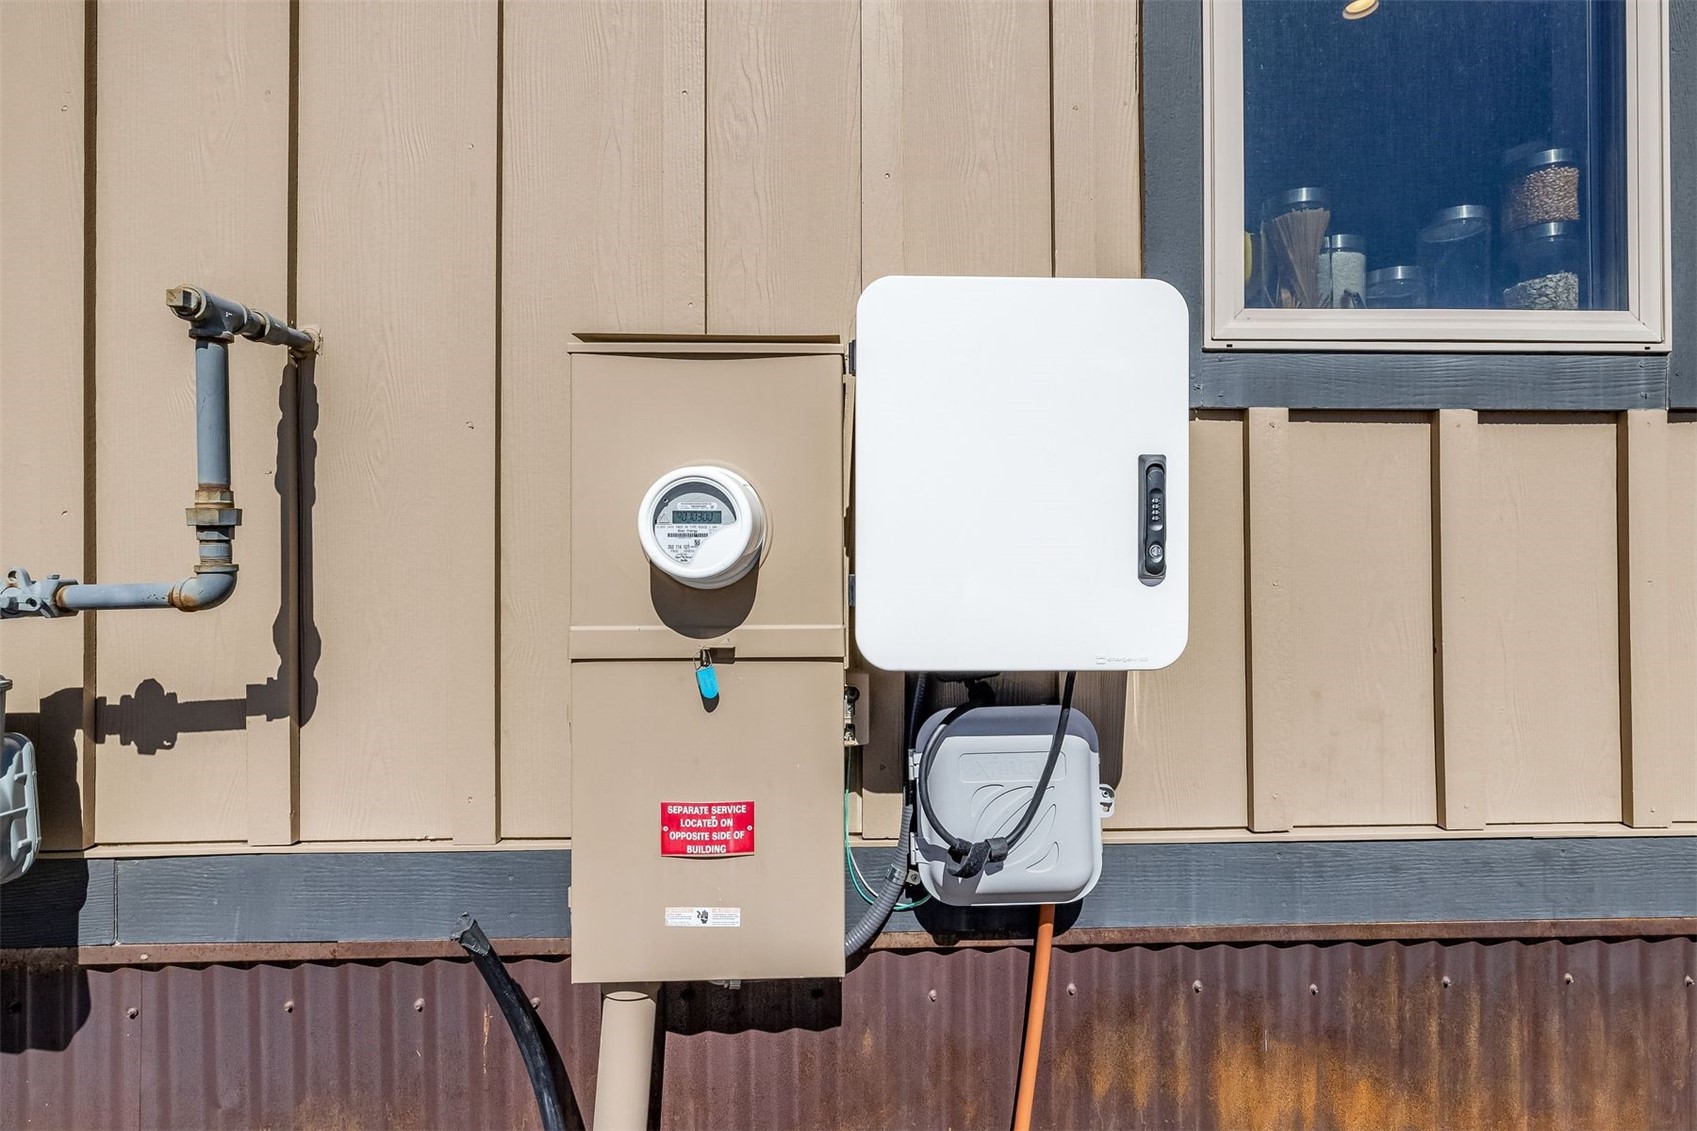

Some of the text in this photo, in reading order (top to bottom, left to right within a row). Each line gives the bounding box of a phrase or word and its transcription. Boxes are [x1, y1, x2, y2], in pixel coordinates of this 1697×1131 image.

[667, 804, 747, 815] SEPARATE SERVICE
[680, 818, 733, 828] LOCATED ON
[669, 830, 745, 840] OPPOSITE SIDE OF
[686, 844, 727, 854] BUILDING
